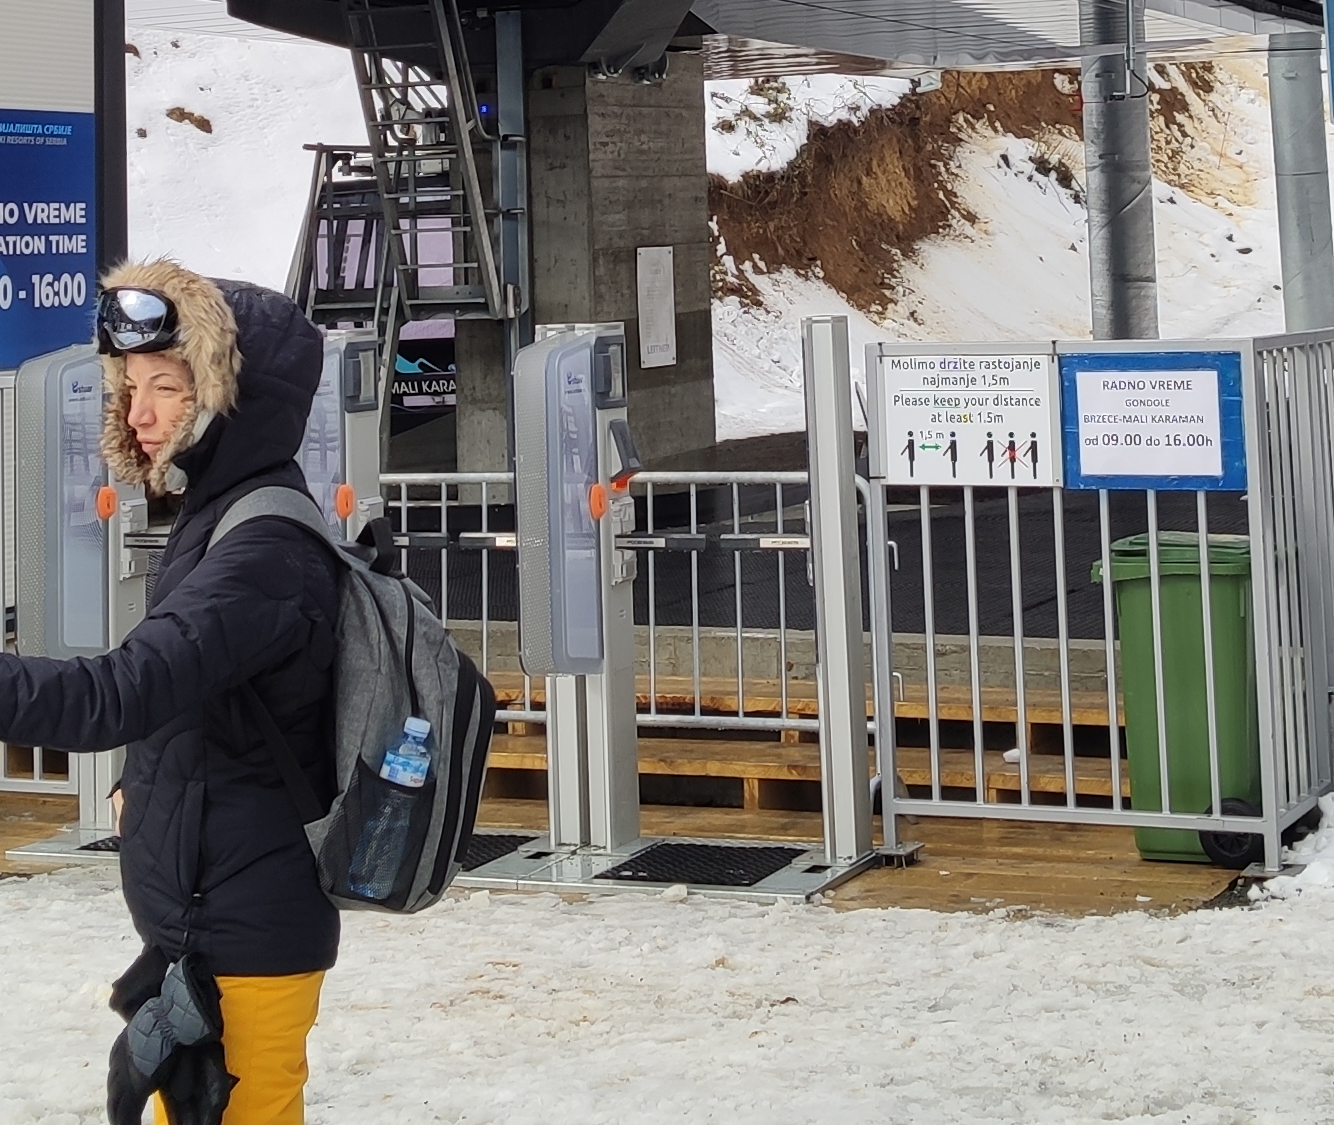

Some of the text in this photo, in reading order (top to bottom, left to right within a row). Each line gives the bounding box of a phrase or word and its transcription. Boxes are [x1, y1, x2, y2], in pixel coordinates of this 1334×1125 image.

[44, 125, 72, 135] СРБИЈЕ
[6, 136, 35, 145] RESORTS
[36, 137, 44, 145] OF
[45, 137, 67, 146] SERBIA
[23, 203, 87, 224] VREME
[49, 235, 87, 254] TIME
[31, 273, 87, 308] 16:00
[891, 358, 1041, 372] Molimo držite rastojanje
[391, 381, 419, 394] MALI
[923, 374, 1009, 388] najmanje 1,5m
[1102, 380, 1193, 391] RADNO VREME
[893, 394, 1041, 408] Please keep your distance
[1125, 399, 1170, 407] GONDOLE
[931, 412, 1004, 423] at least 1.5m
[1083, 414, 1204, 424] BRZECE-MALI KARAMAN
[919, 431, 933, 440] 1,5
[1084, 433, 1213, 446] od 09.00 do 16.00h
